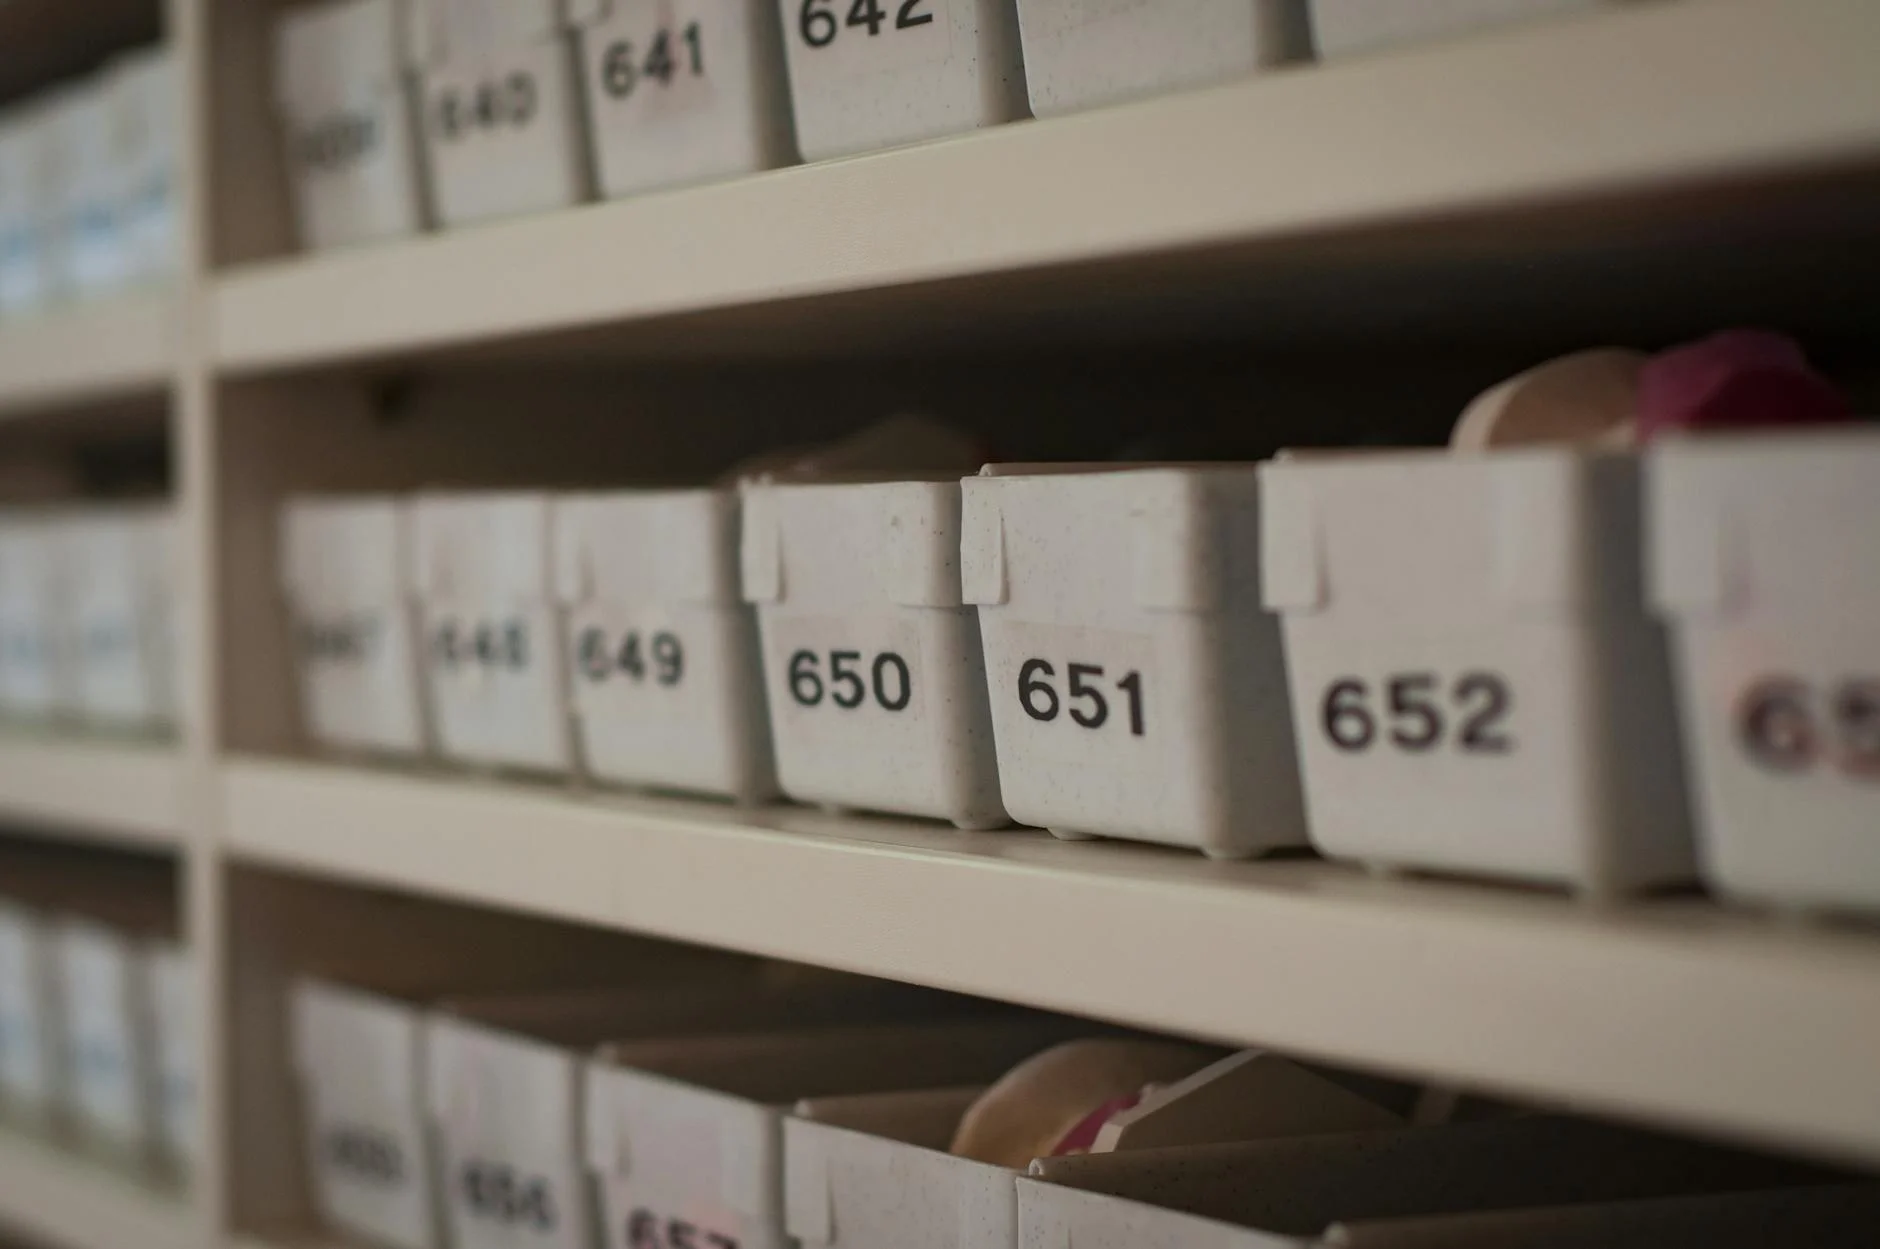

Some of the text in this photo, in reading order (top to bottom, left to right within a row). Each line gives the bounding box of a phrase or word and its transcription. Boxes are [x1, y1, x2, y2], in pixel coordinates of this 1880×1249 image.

[799, 0, 933, 47] 642
[602, 22, 705, 97] 641
[579, 627, 684, 684] 649
[788, 650, 912, 711] 650
[1017, 658, 1146, 737] 651
[1322, 672, 1514, 753] 652
